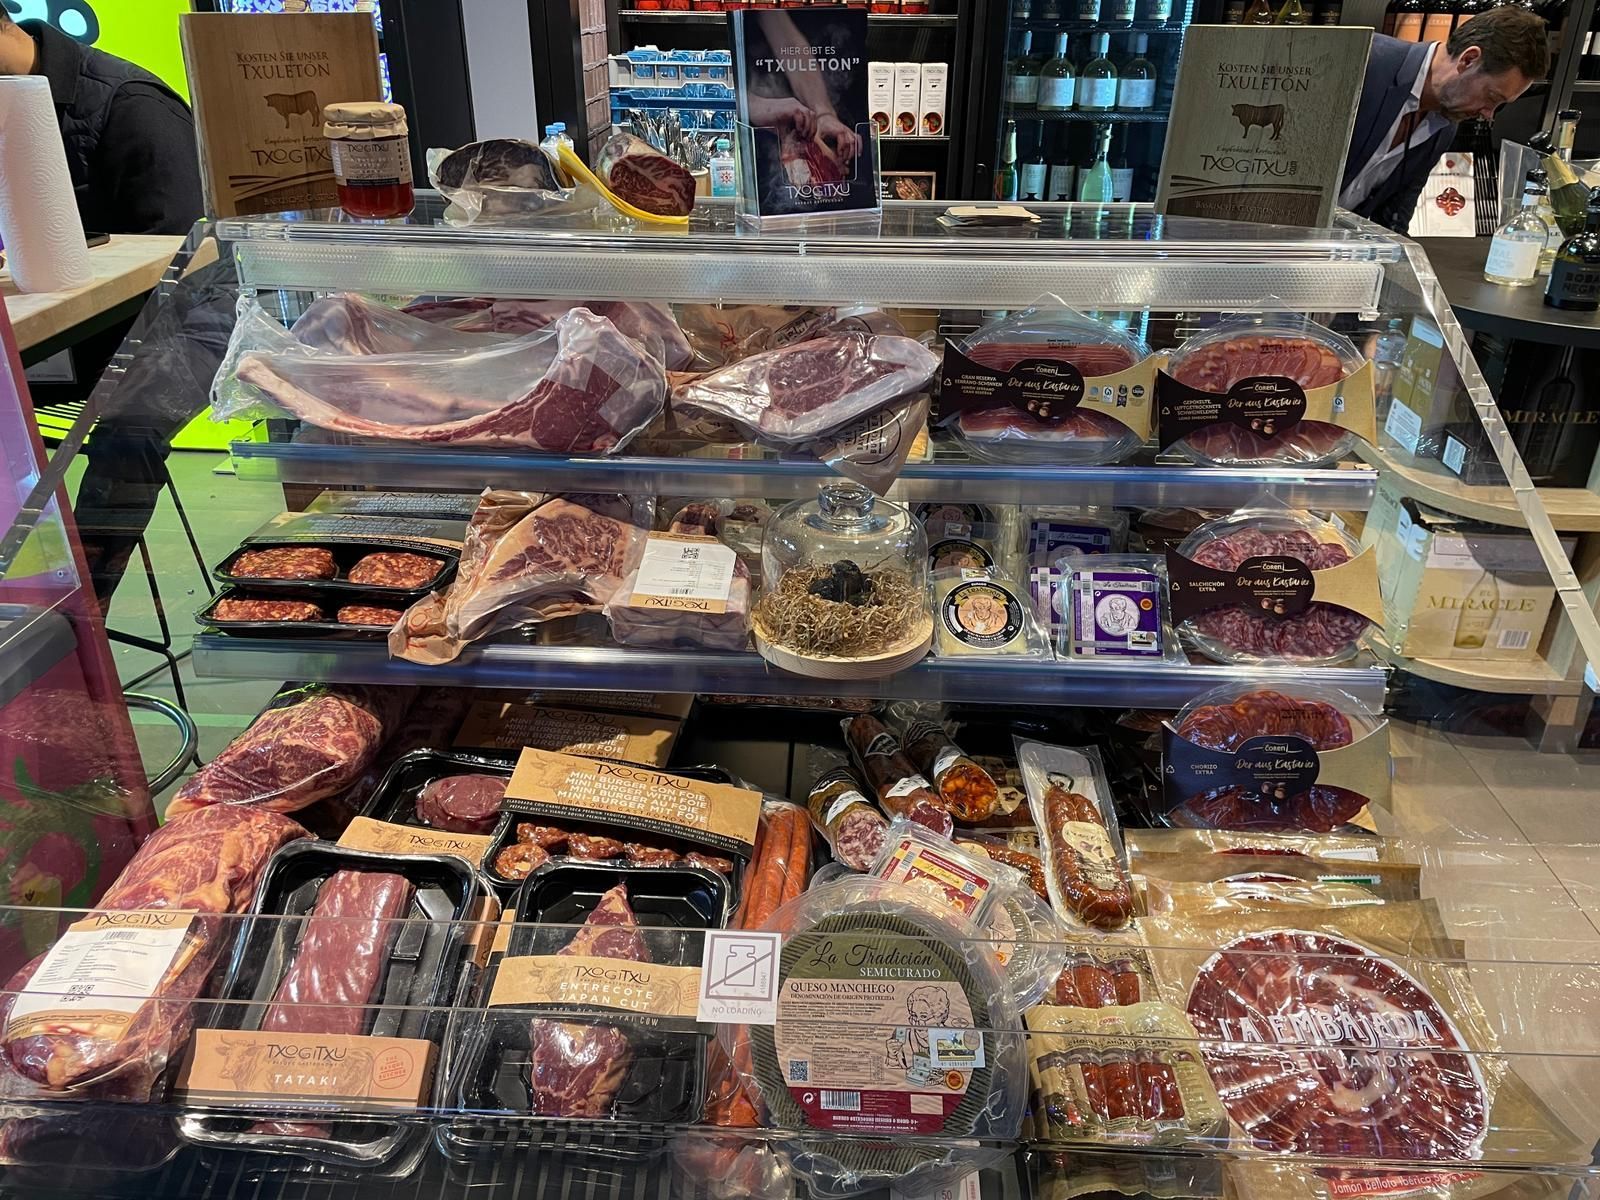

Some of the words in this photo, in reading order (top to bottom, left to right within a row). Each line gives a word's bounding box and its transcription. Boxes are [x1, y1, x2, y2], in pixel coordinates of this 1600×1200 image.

[236, 52, 277, 63] KOSTEN
[297, 51, 329, 61] UNSER
[780, 46, 801, 56] HIER
[802, 46, 823, 56] GIBT
[824, 46, 836, 55] ES
[1218, 62, 1258, 73] KOSTEN
[1278, 66, 1312, 76] UNSER
[785, 182, 851, 199] TXOGITXU
[1427, 595, 1536, 612] MIRACLE
[598, 744, 624, 755] FOIE
[594, 762, 691, 790] TXOGITXU
[564, 777, 593, 789] MINI
[594, 781, 643, 797] BURGER
[646, 790, 678, 803] WITH
[680, 797, 708, 809] FOIE
[570, 770, 597, 782] MINI
[598, 775, 647, 791] BURGER
[650, 783, 676, 795] CON
[679, 790, 707, 802] FOIE
[557, 790, 646, 812] MINI-BURGER
[649, 805, 673, 817] MIT
[676, 810, 708, 825] FOIE
[570, 784, 597, 796] MINI
[599, 789, 648, 804] BURGER
[651, 798, 669, 809] AU
[671, 802, 698, 814] FOIE
[409, 834, 472, 850] TXOGITXU
[806, 941, 839, 971] La
[844, 943, 935, 967] Tradición
[573, 965, 651, 986] TXOGITXU
[859, 966, 942, 979] SEMICURADO
[559, 981, 654, 1000] ENTRECOTE
[790, 982, 828, 993] QUESO
[830, 983, 895, 994] MANCHEGO
[558, 992, 611, 1005] JAPAN
[619, 998, 651, 1011] CUT
[711, 1005, 725, 1014] NO
[726, 1006, 763, 1016] LOADING
[267, 1044, 348, 1062] TXOGITXU
[274, 1074, 338, 1086] TATAKI
[1333, 1178, 1363, 1195] Jamón
[1365, 1177, 1397, 1191] Bellota
